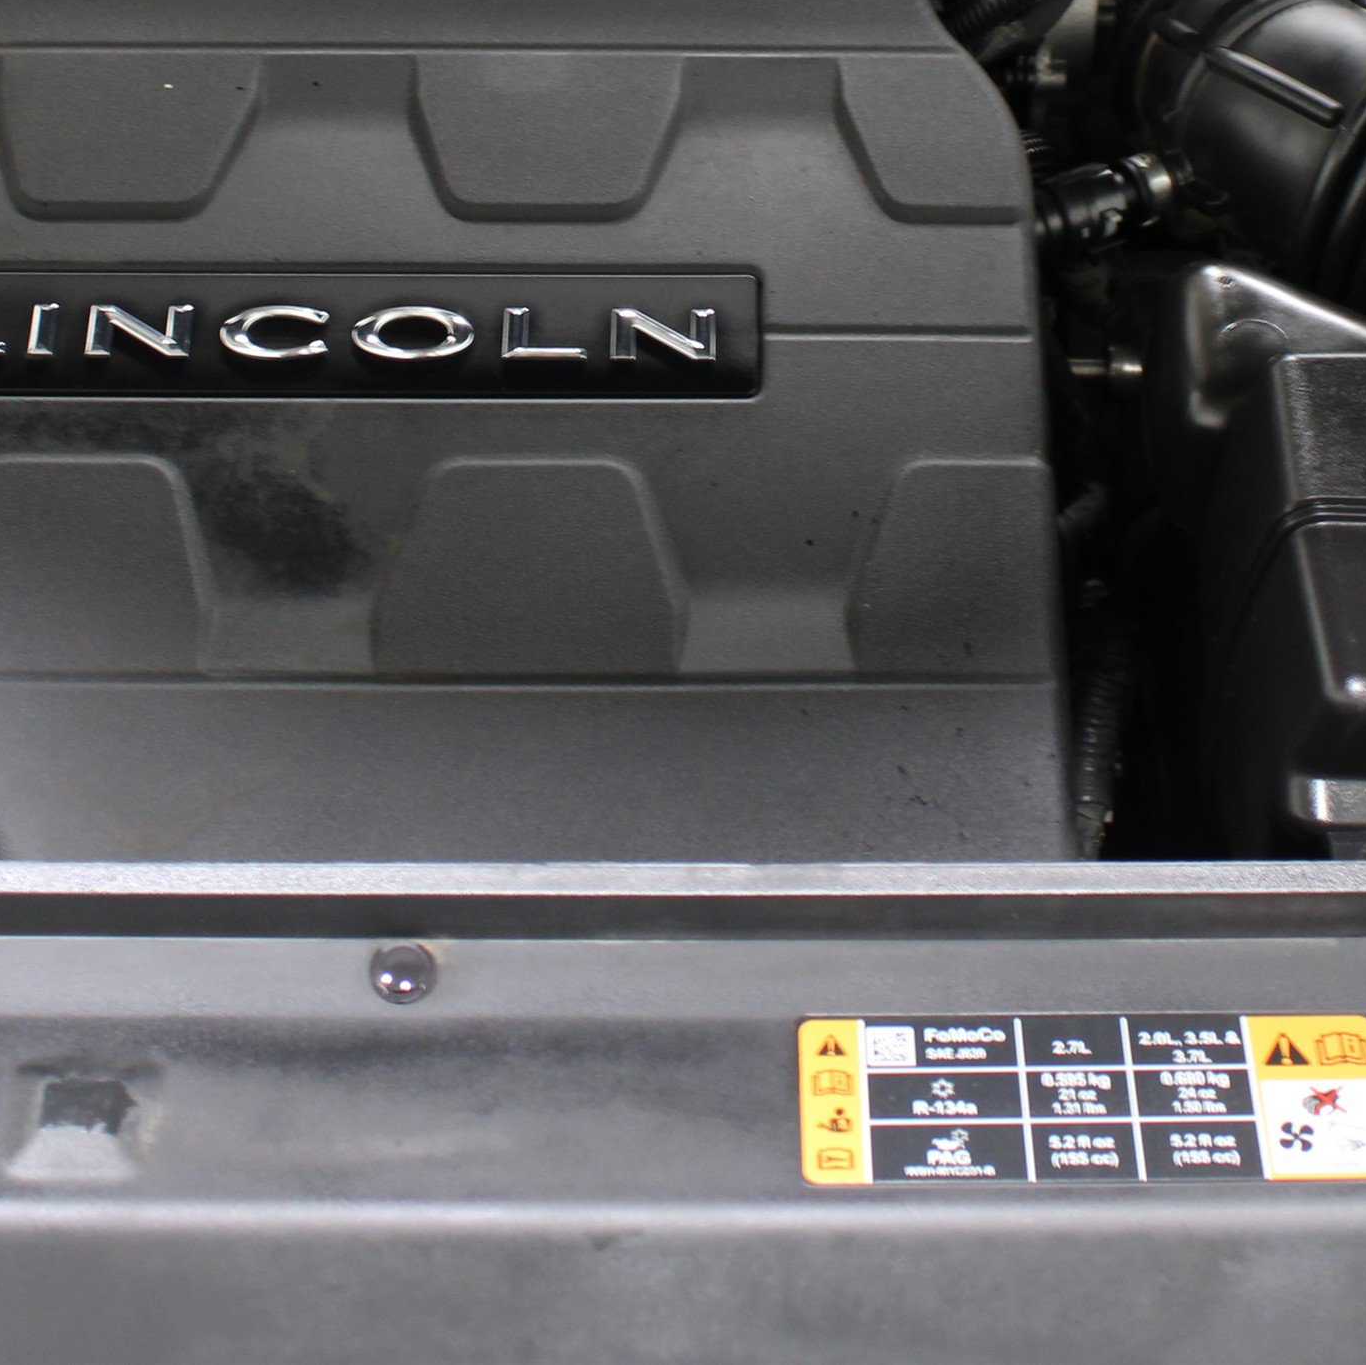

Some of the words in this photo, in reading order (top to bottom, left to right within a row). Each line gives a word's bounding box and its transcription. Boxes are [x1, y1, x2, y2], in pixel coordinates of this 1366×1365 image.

[923, 1027, 1007, 1044] FoMoCo
[1051, 1040, 1093, 1056] 2.7L
[1172, 1049, 1213, 1064] 3.7L
[1088, 1073, 1112, 1091] kg
[1206, 1071, 1231, 1089] kg
[912, 1100, 978, 1116] R-134a
[927, 1149, 972, 1166] PAG
